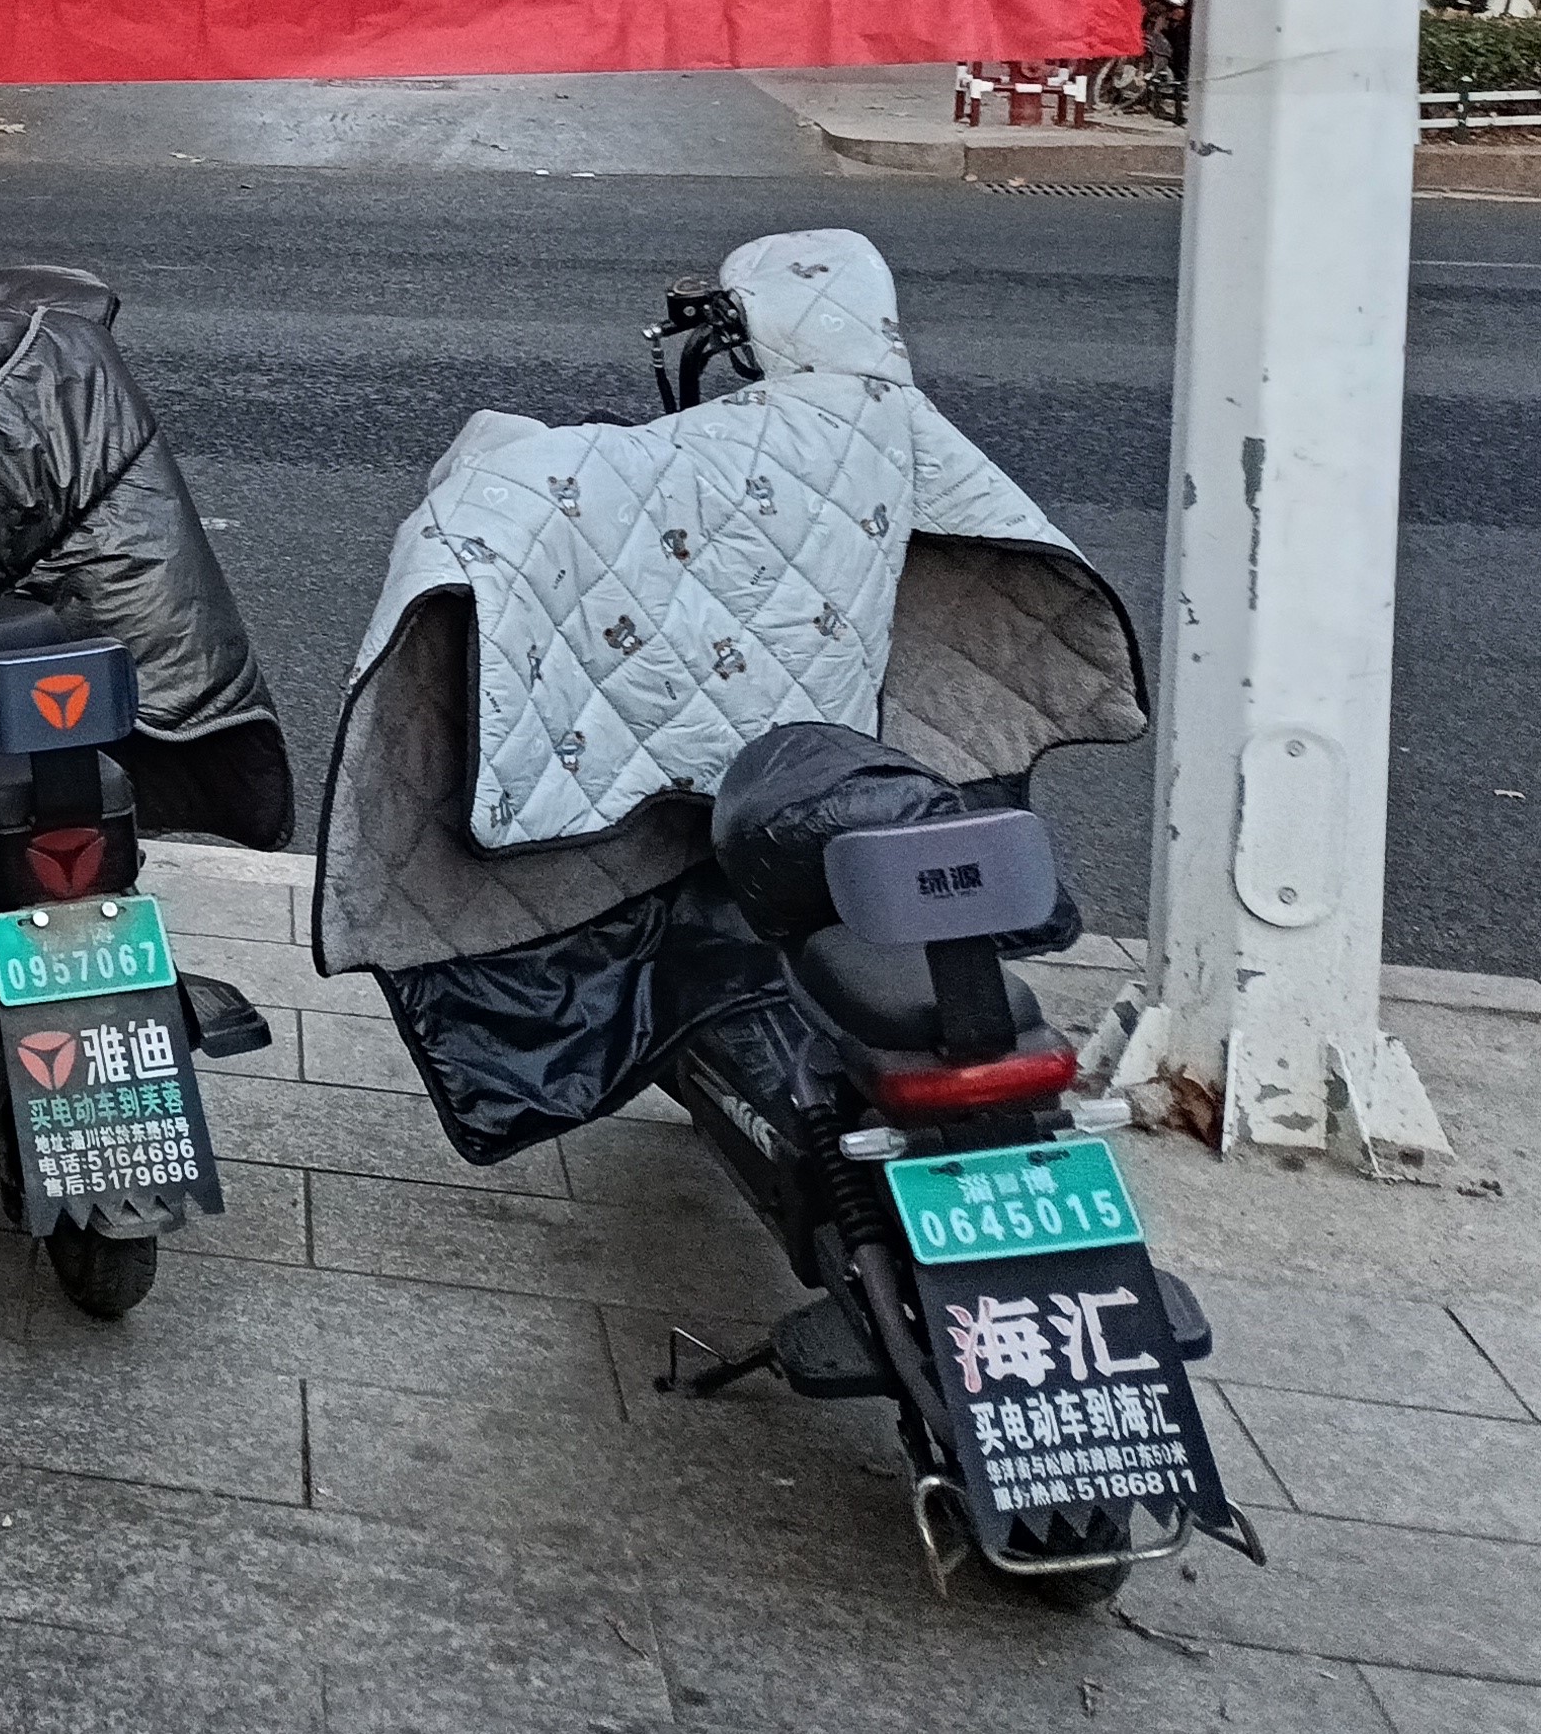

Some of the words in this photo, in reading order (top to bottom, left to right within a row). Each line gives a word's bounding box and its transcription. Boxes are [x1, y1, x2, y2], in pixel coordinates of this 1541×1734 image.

[7, 941, 156, 991] 0957067
[80, 1019, 179, 1085] 雅迪
[28, 1080, 184, 1132] 买电动车到芙蓉
[38, 1138, 195, 1177] 电话:5164696
[43, 1160, 199, 1198] 售后:5179696
[921, 1189, 1121, 1248] 0645015
[946, 1286, 1160, 1393] 海汇
[970, 1383, 1181, 1456] 买电动车到海汇
